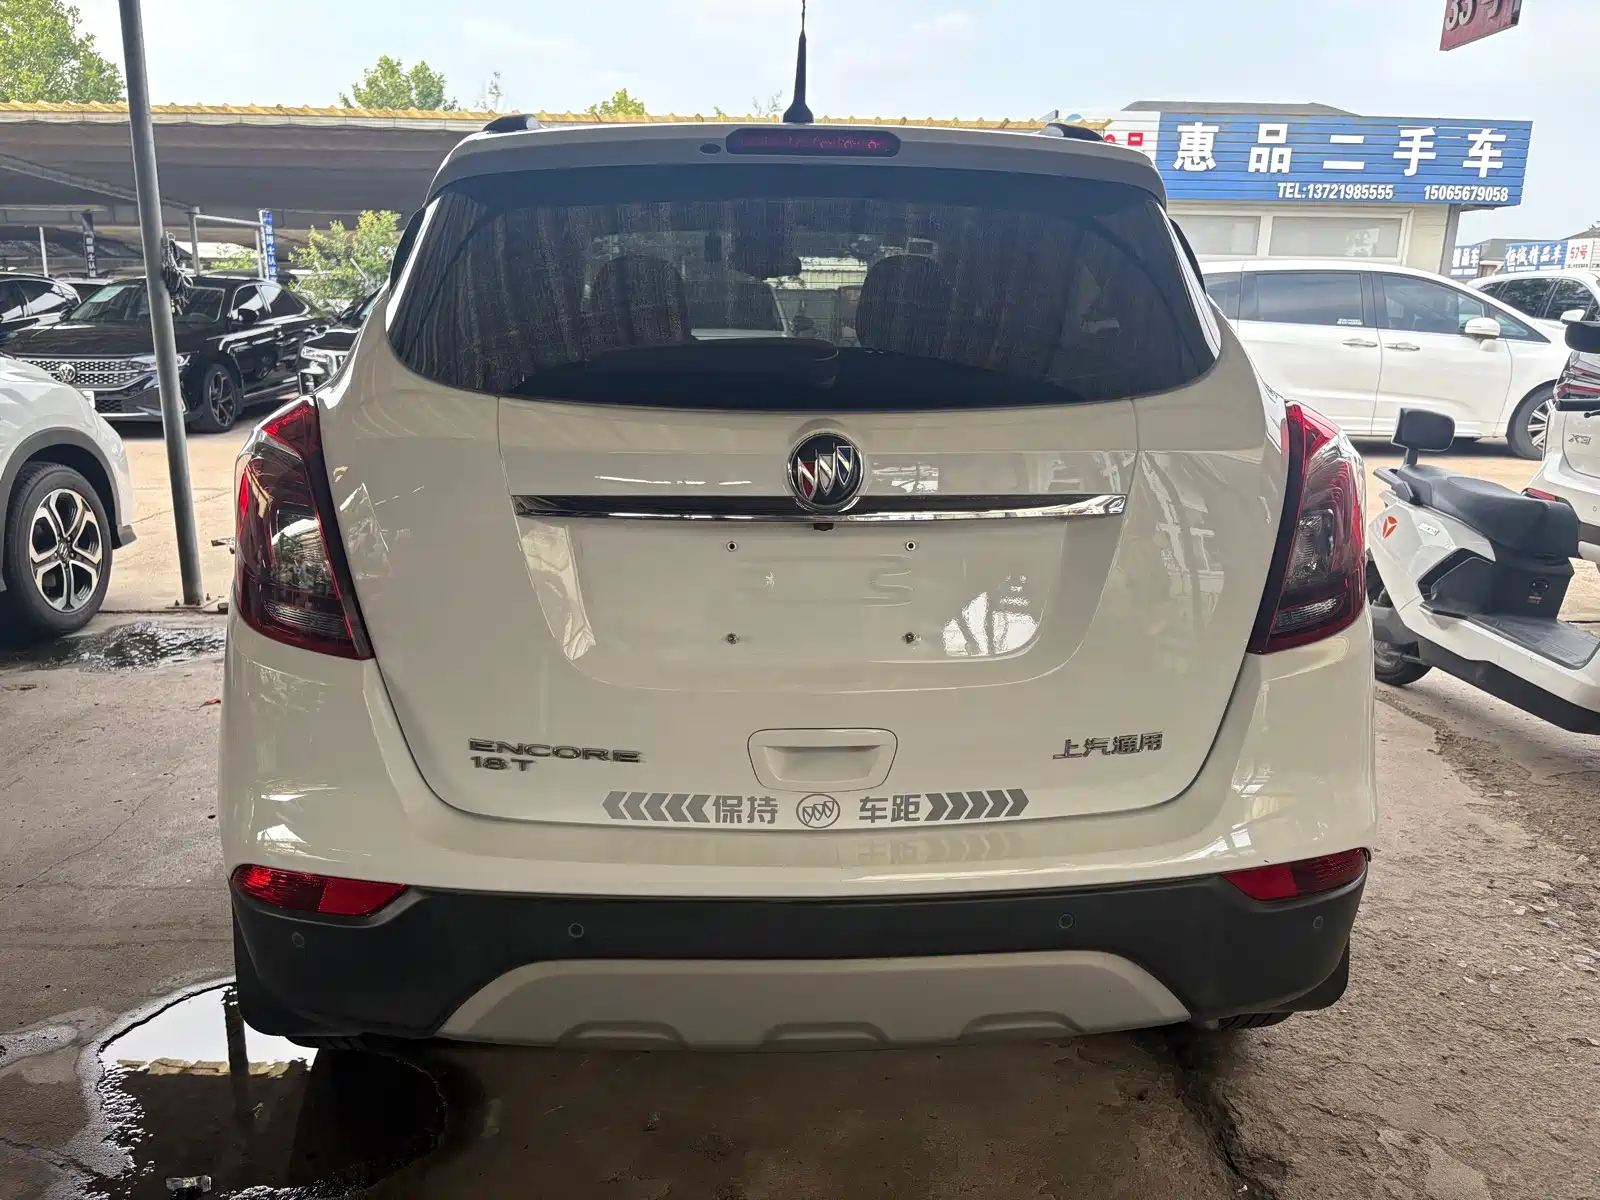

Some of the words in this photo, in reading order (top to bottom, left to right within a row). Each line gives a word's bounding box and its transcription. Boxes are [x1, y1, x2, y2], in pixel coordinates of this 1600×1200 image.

[1173, 122, 1506, 177] 惠品二手车
[1277, 182, 1395, 200] TEL:13721985555
[1423, 185, 1509, 202] 15065679058
[468, 737, 642, 763] ENCORE
[1052, 731, 1163, 760] 上汽通用
[712, 794, 778, 825] 保持
[858, 794, 923, 824] 车距
